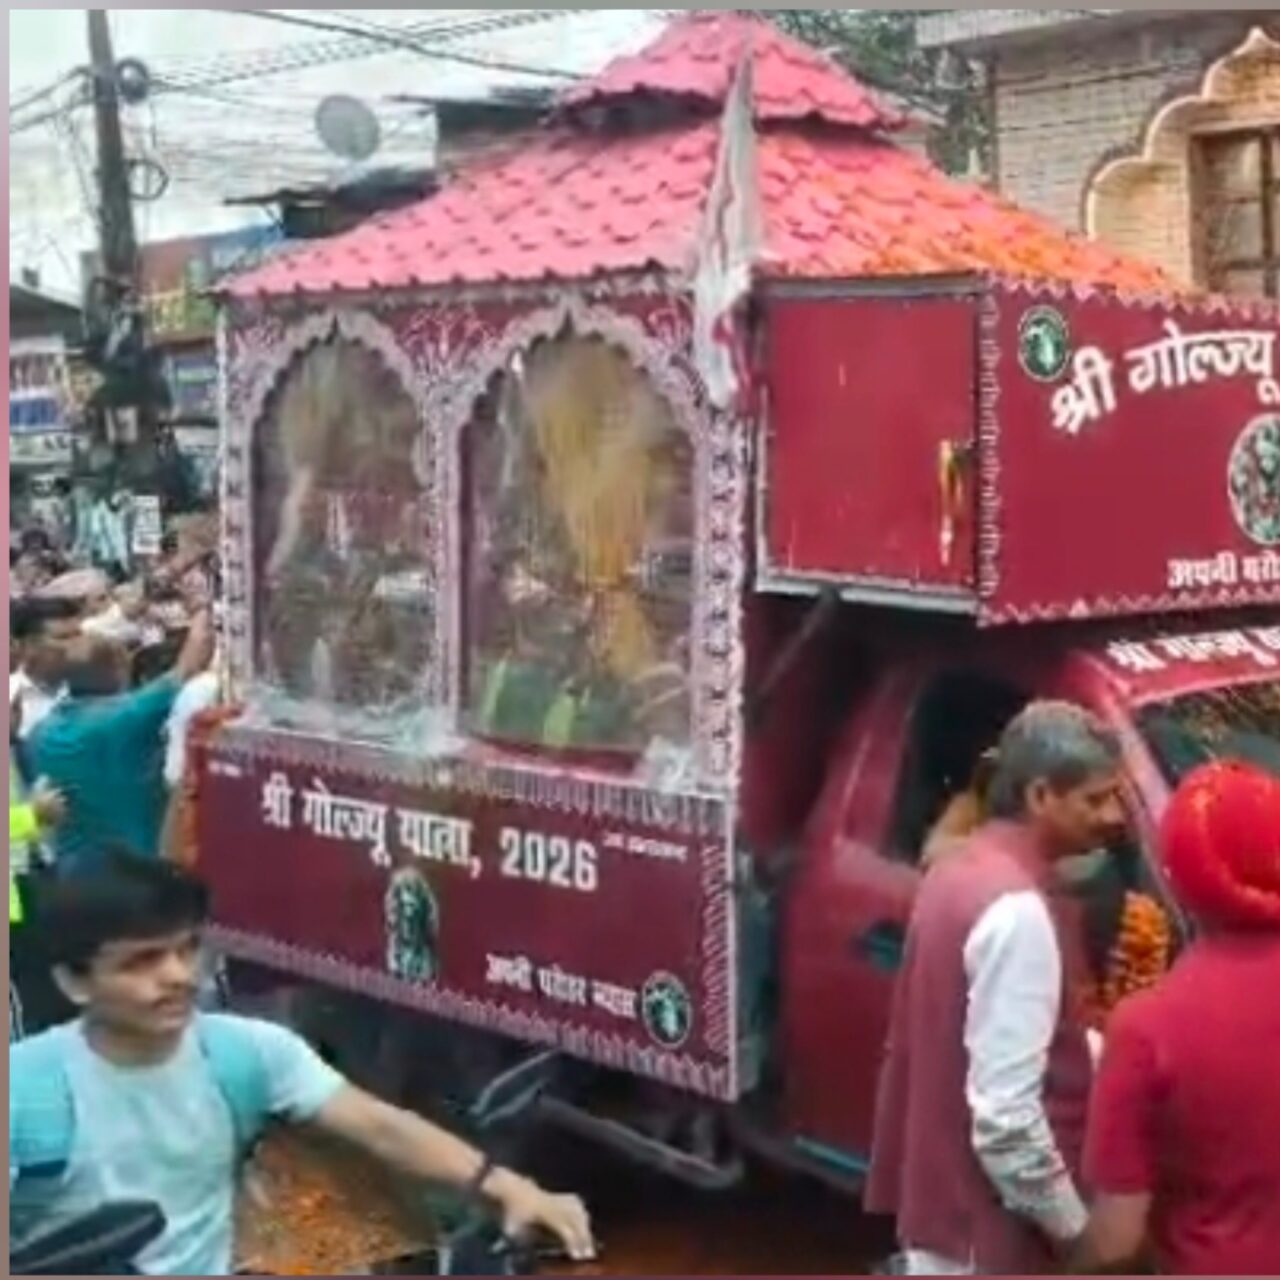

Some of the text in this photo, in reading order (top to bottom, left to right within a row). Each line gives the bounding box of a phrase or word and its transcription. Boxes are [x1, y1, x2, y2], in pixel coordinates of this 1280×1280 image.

[1052, 346, 1116, 434] श्री
[262, 771, 294, 829] श्री
[499, 826, 598, 893] 2026
